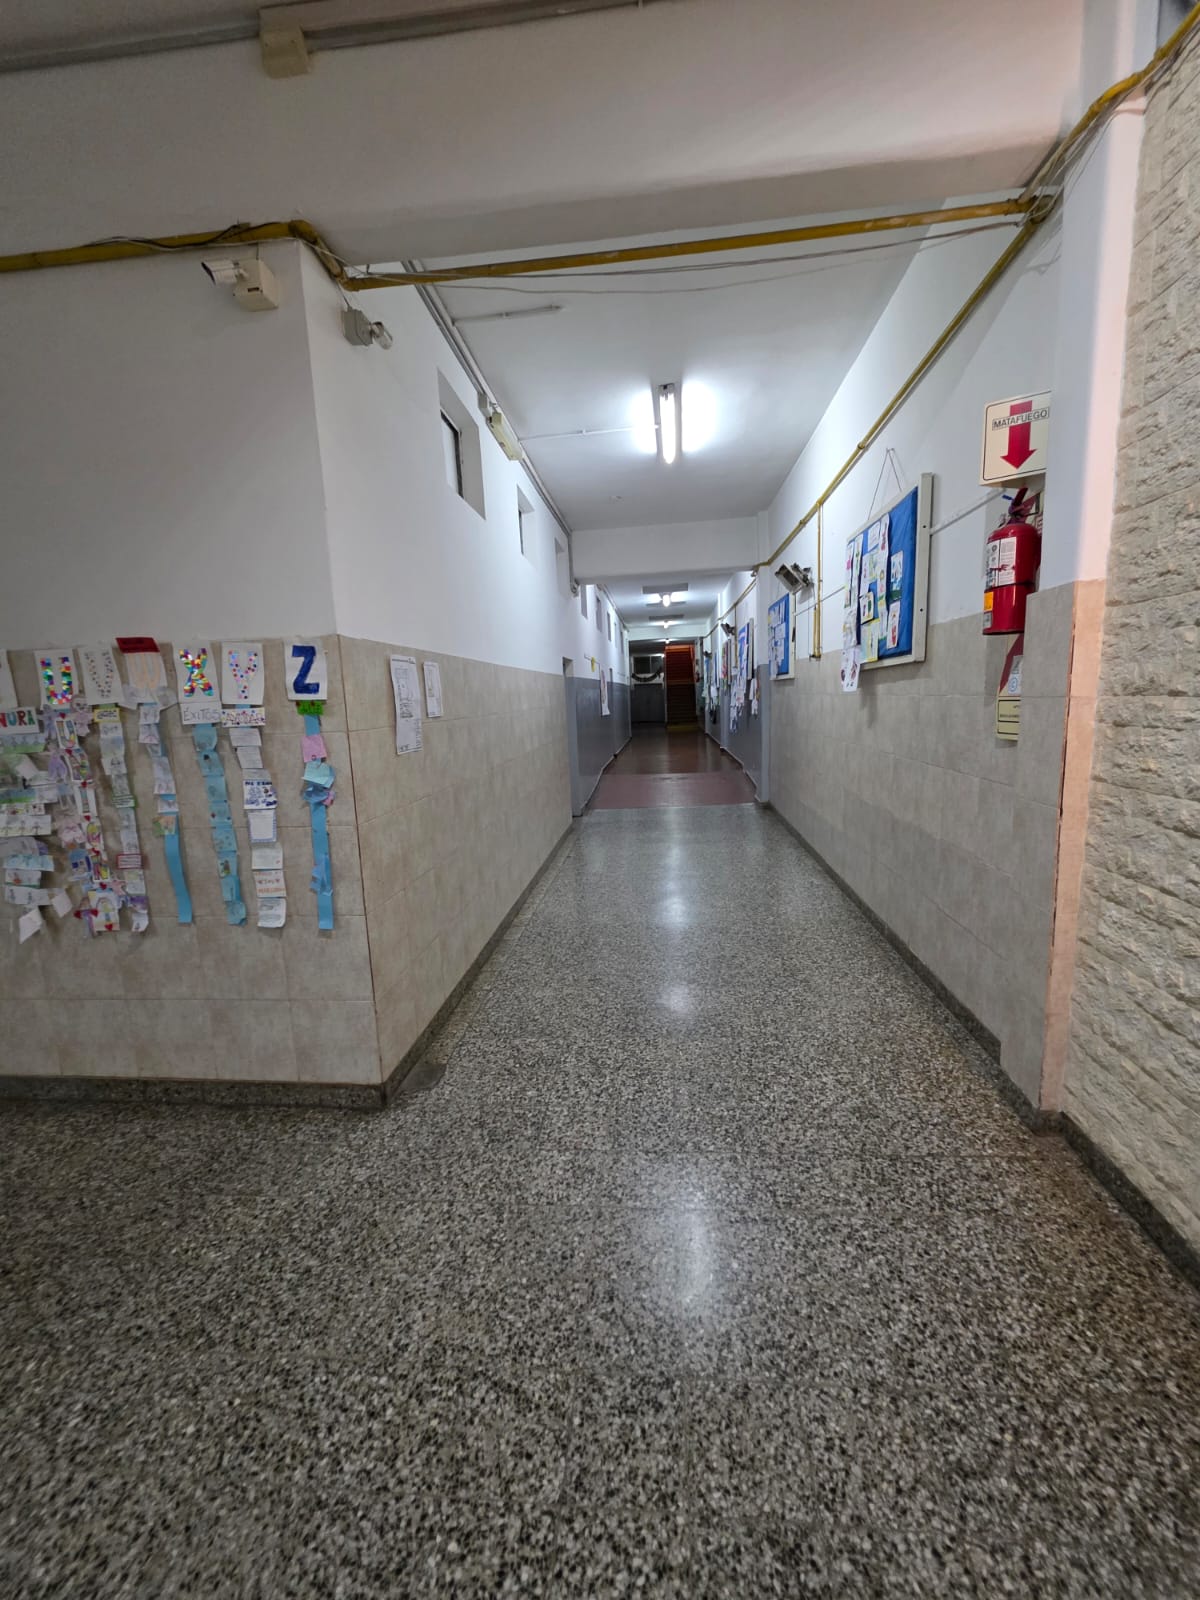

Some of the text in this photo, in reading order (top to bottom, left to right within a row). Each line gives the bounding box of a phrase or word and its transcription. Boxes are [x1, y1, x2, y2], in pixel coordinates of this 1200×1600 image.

[993, 409, 1048, 428] MATAFUEGO
[38, 656, 73, 704] U
[179, 648, 214, 698] X
[227, 649, 259, 700] Y
[291, 644, 320, 694] Z
